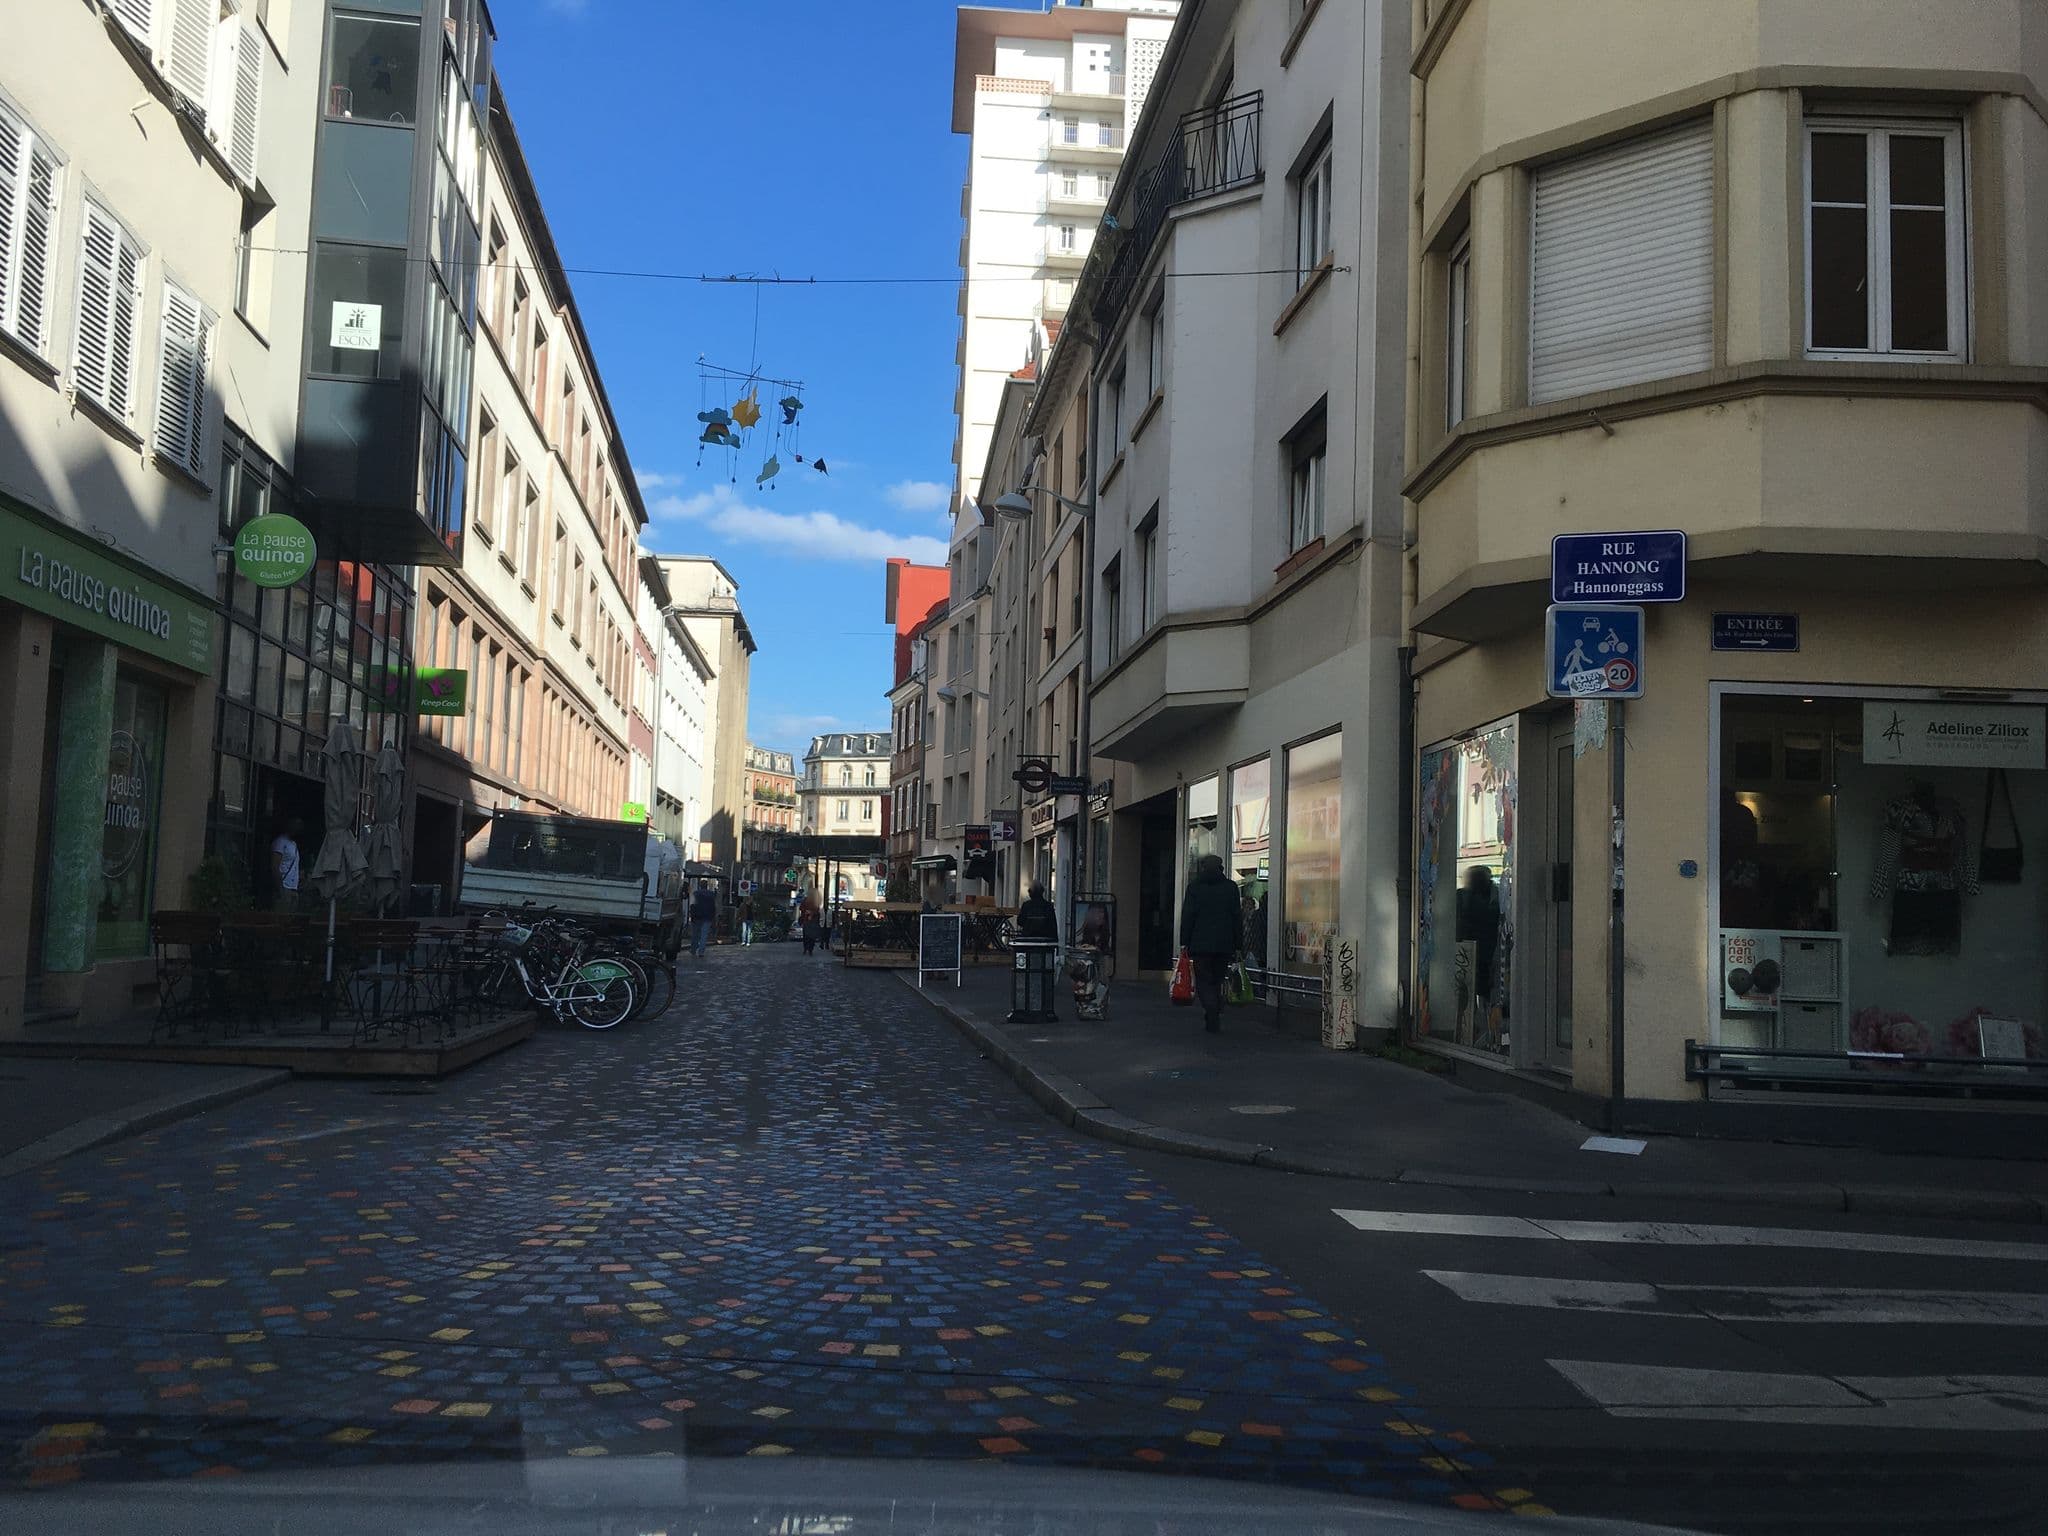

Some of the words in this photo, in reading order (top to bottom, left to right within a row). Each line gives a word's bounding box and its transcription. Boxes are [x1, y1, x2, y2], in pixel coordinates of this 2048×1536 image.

[242, 534, 259, 545] La
[263, 534, 305, 548] pause
[1602, 542, 1635, 556] RUE
[1578, 560, 1660, 575] HANNONG
[20, 545, 43, 588] La
[48, 559, 104, 613] pause
[1573, 581, 1664, 596] Hannonggass
[1728, 617, 1784, 630] ENTRÉE
[1611, 668, 1629, 680] 20
[1927, 721, 1984, 735] Adeline
[1988, 723, 2029, 737] Ziliox
[111, 774, 141, 798] pause
[105, 796, 140, 829] uinoa
[1728, 946, 1751, 955] nan
